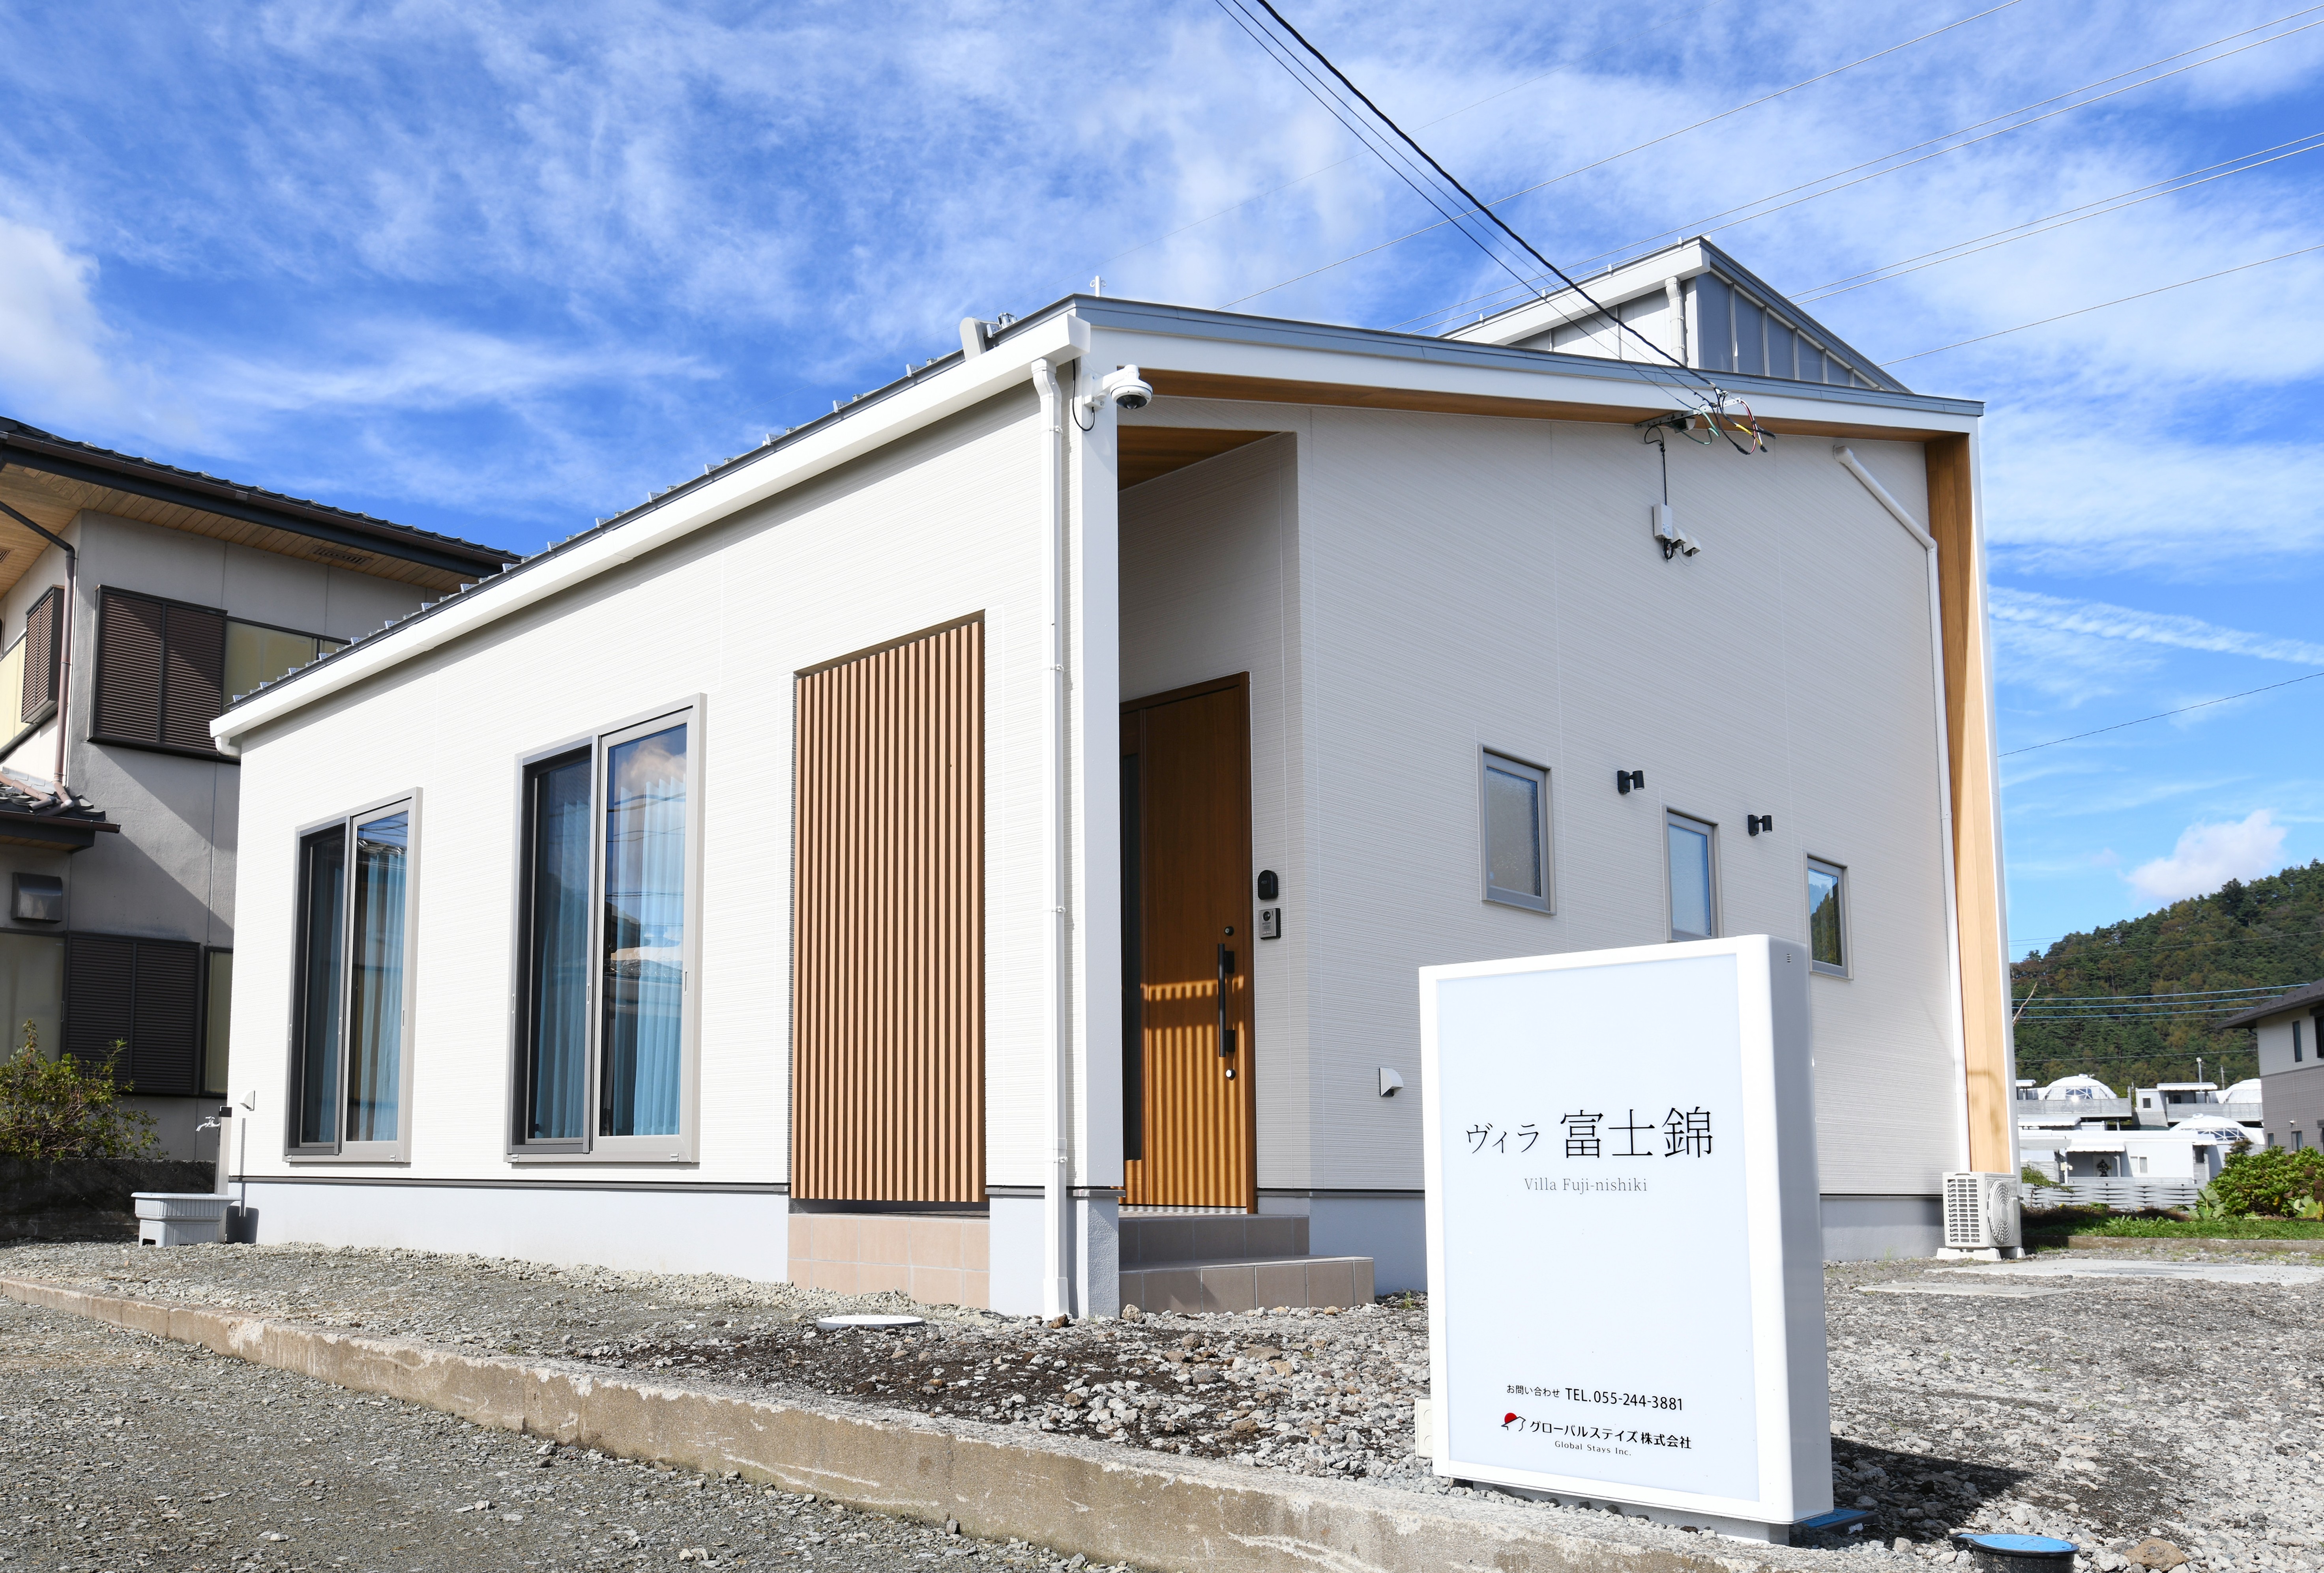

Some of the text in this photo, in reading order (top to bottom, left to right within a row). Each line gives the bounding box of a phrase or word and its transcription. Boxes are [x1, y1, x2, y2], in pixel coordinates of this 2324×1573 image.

[1466, 1106, 1713, 1158] ヴィラ 富士錦
[1524, 1177, 1647, 1195] Villa Fuji-nishiki
[1506, 1384, 1560, 1398] お問い合わせ
[1530, 1421, 1692, 1449] グローバルステイズ株式会社
[1555, 1440, 1631, 1456] Global Stays Inc.
